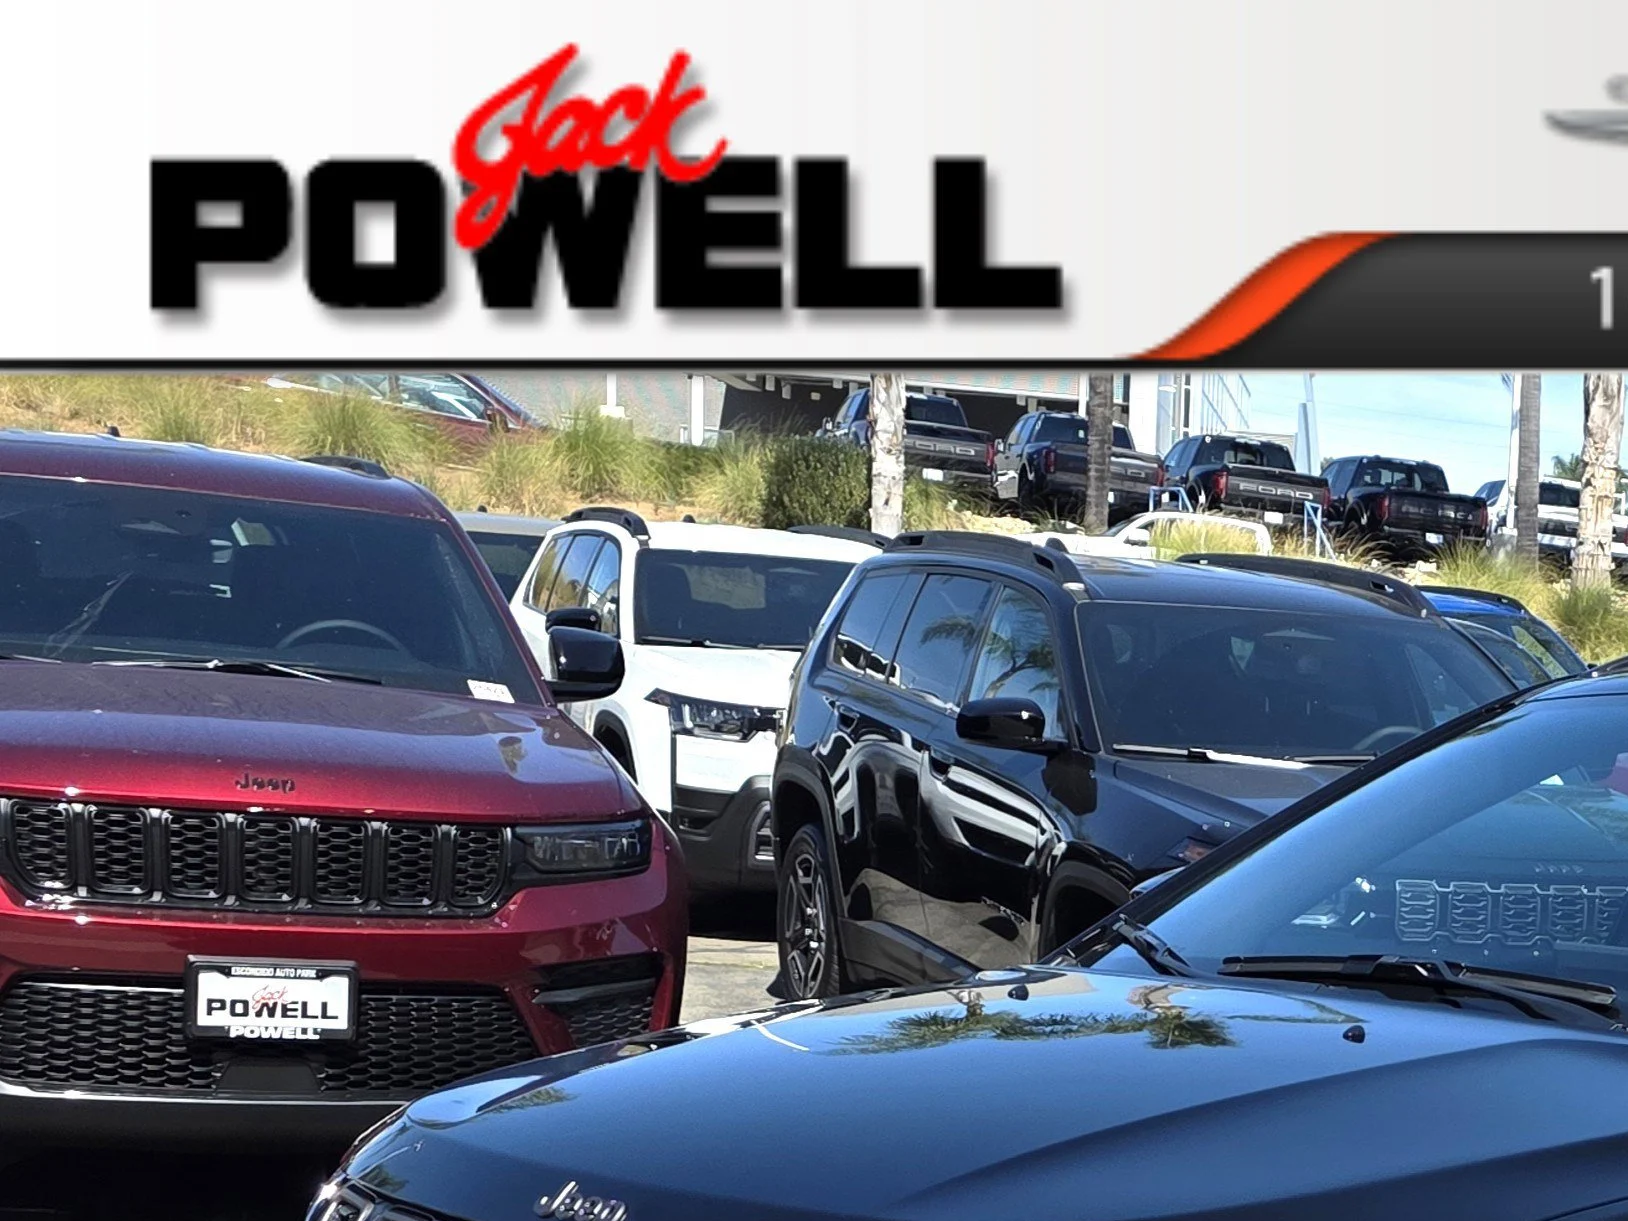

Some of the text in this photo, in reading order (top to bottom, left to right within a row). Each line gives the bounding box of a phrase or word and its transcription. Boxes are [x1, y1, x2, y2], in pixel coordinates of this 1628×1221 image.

[1239, 483, 1313, 499] FORD
[234, 772, 296, 795] Jeep
[274, 967, 295, 978] AUTO
[296, 968, 317, 979] PARK
[206, 998, 339, 1020] POWELL
[229, 1025, 320, 1040] POWELL
